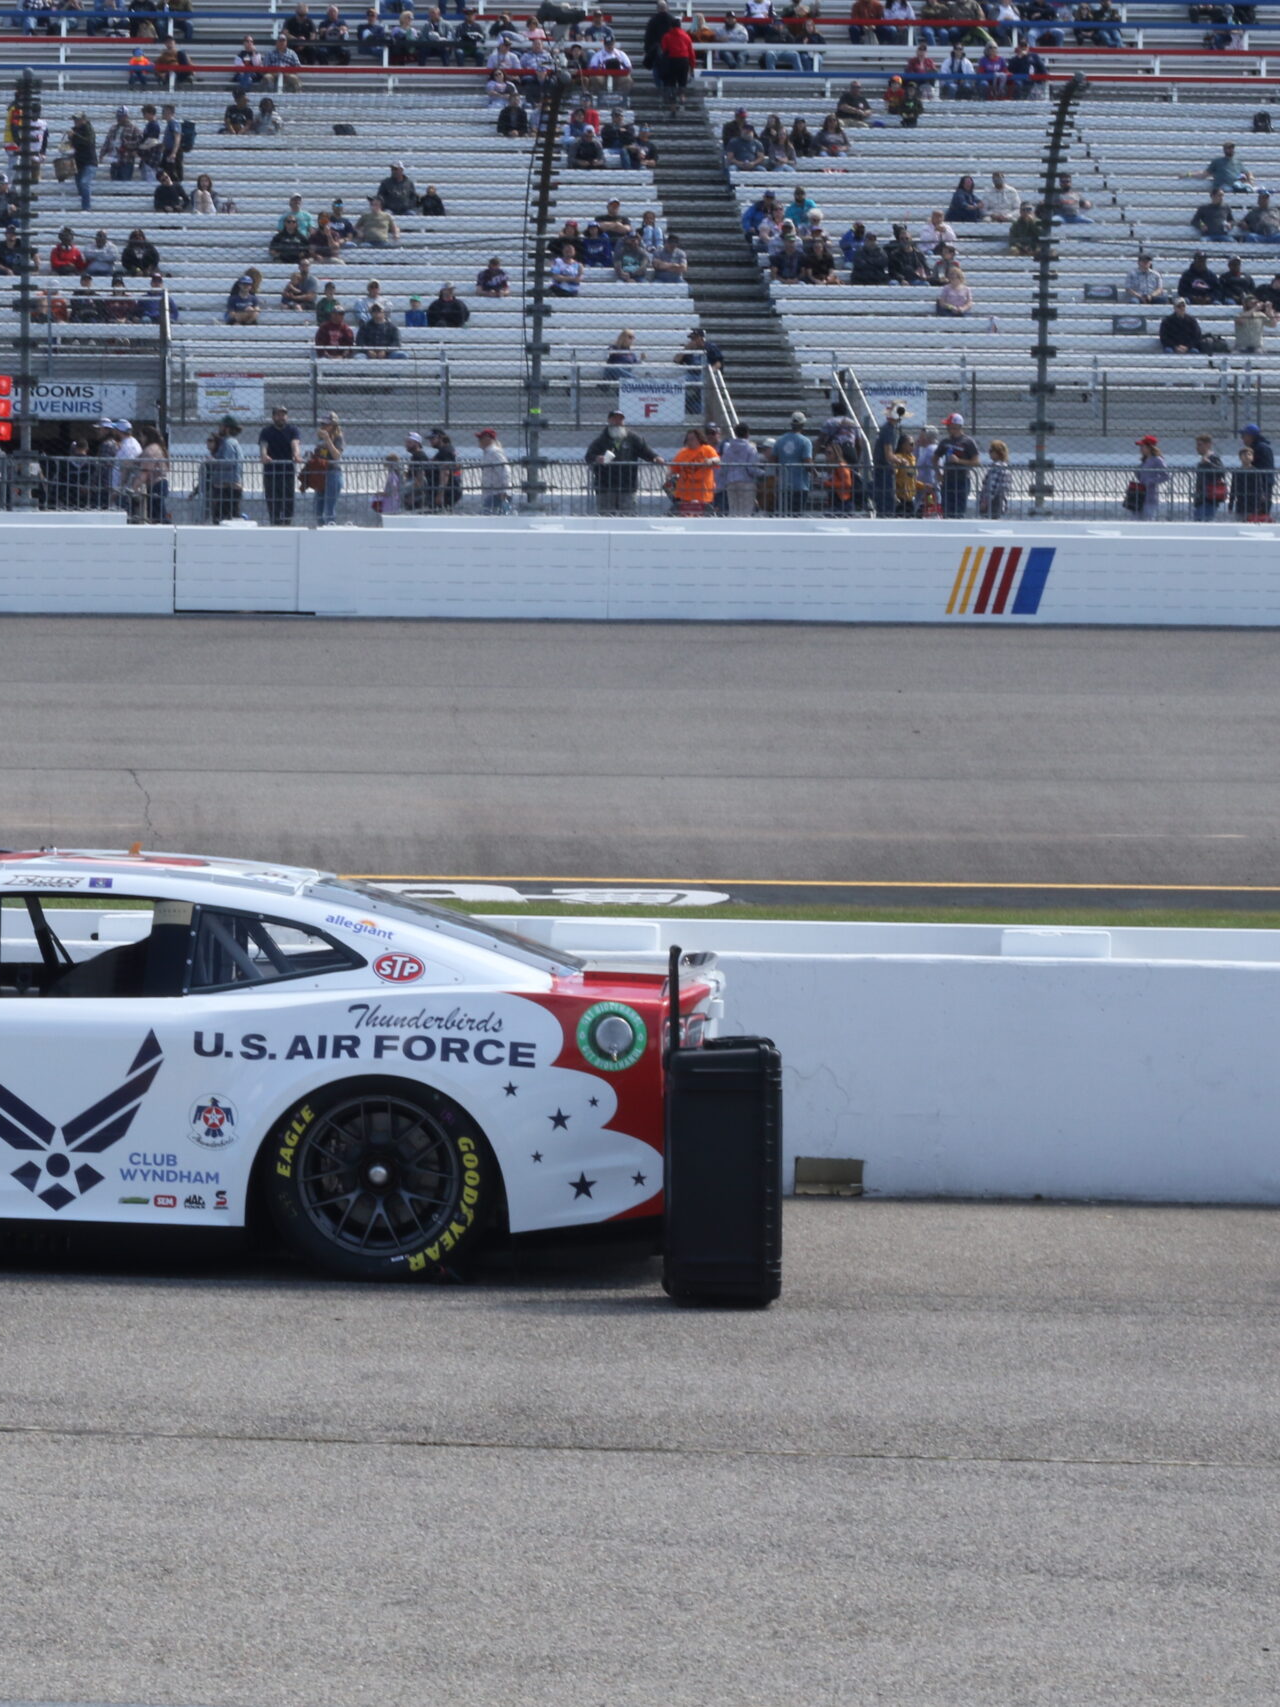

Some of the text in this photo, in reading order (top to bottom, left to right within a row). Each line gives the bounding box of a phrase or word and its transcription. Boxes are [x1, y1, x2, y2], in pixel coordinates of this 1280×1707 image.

[621, 384, 683, 394] COMMONWEALTH
[644, 403, 659, 419] F
[325, 912, 395, 941] allegiant
[377, 955, 420, 979] STP
[347, 1003, 505, 1033] Thunderbirds
[193, 1031, 537, 1069] U.S. AIR FORCE
[276, 1104, 316, 1179] EAGLE
[129, 1152, 178, 1168] CLUB
[119, 1168, 220, 1185] WYNDHAM
[408, 1136, 481, 1272] GOODYEAR
